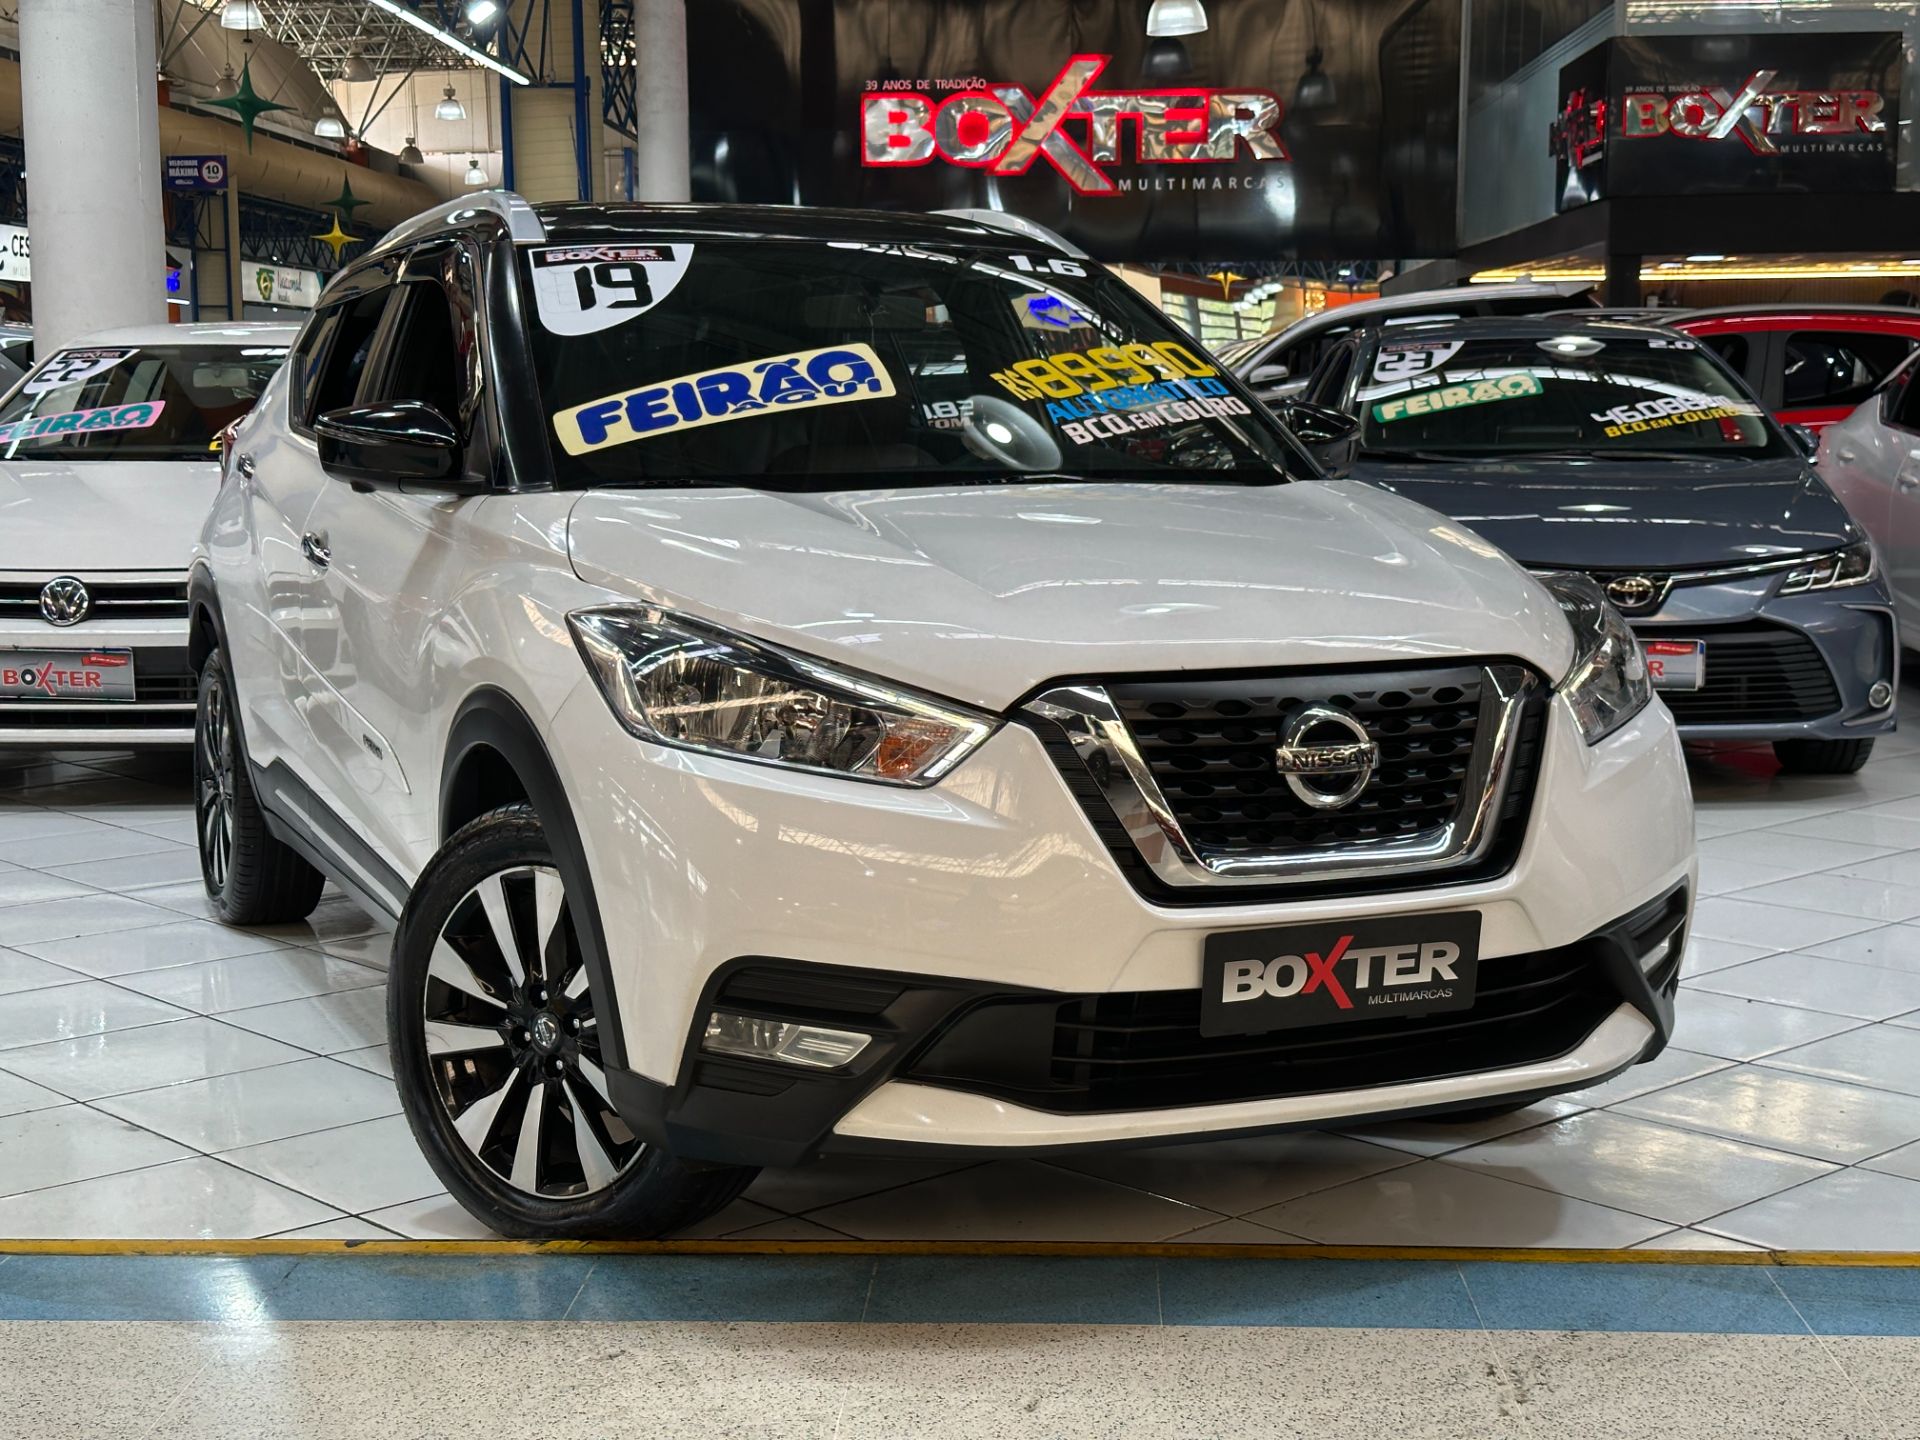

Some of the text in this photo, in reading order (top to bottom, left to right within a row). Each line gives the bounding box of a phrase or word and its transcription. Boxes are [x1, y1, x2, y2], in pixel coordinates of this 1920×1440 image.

[865, 76, 987, 91] 39 ANOS DE TRADIÇÃO
[1623, 69, 1887, 156] BOXTER
[861, 54, 1292, 196] BOXTER
[1780, 142, 1884, 153] MULTIMARCAS
[205, 165, 220, 175] 10
[1118, 176, 1285, 191] MULTIMARCAS
[545, 247, 659, 263] BOXTER
[1008, 255, 1088, 278] 1.6
[573, 262, 654, 311] 19
[1648, 338, 1696, 351] 2.0
[33, 359, 102, 384] 22
[1378, 351, 1434, 372] 23
[575, 350, 876, 445] FEIRÃO
[1380, 374, 1537, 420] FEIRÃO
[1129, 404, 1166, 431] EM
[1155, 395, 1252, 425] COURO
[2, 660, 103, 696] BOXTER
[1291, 749, 1375, 769] NISSAN
[1221, 935, 1461, 1010] BOXTER
[1368, 988, 1453, 1006] MULTIMARCAS
